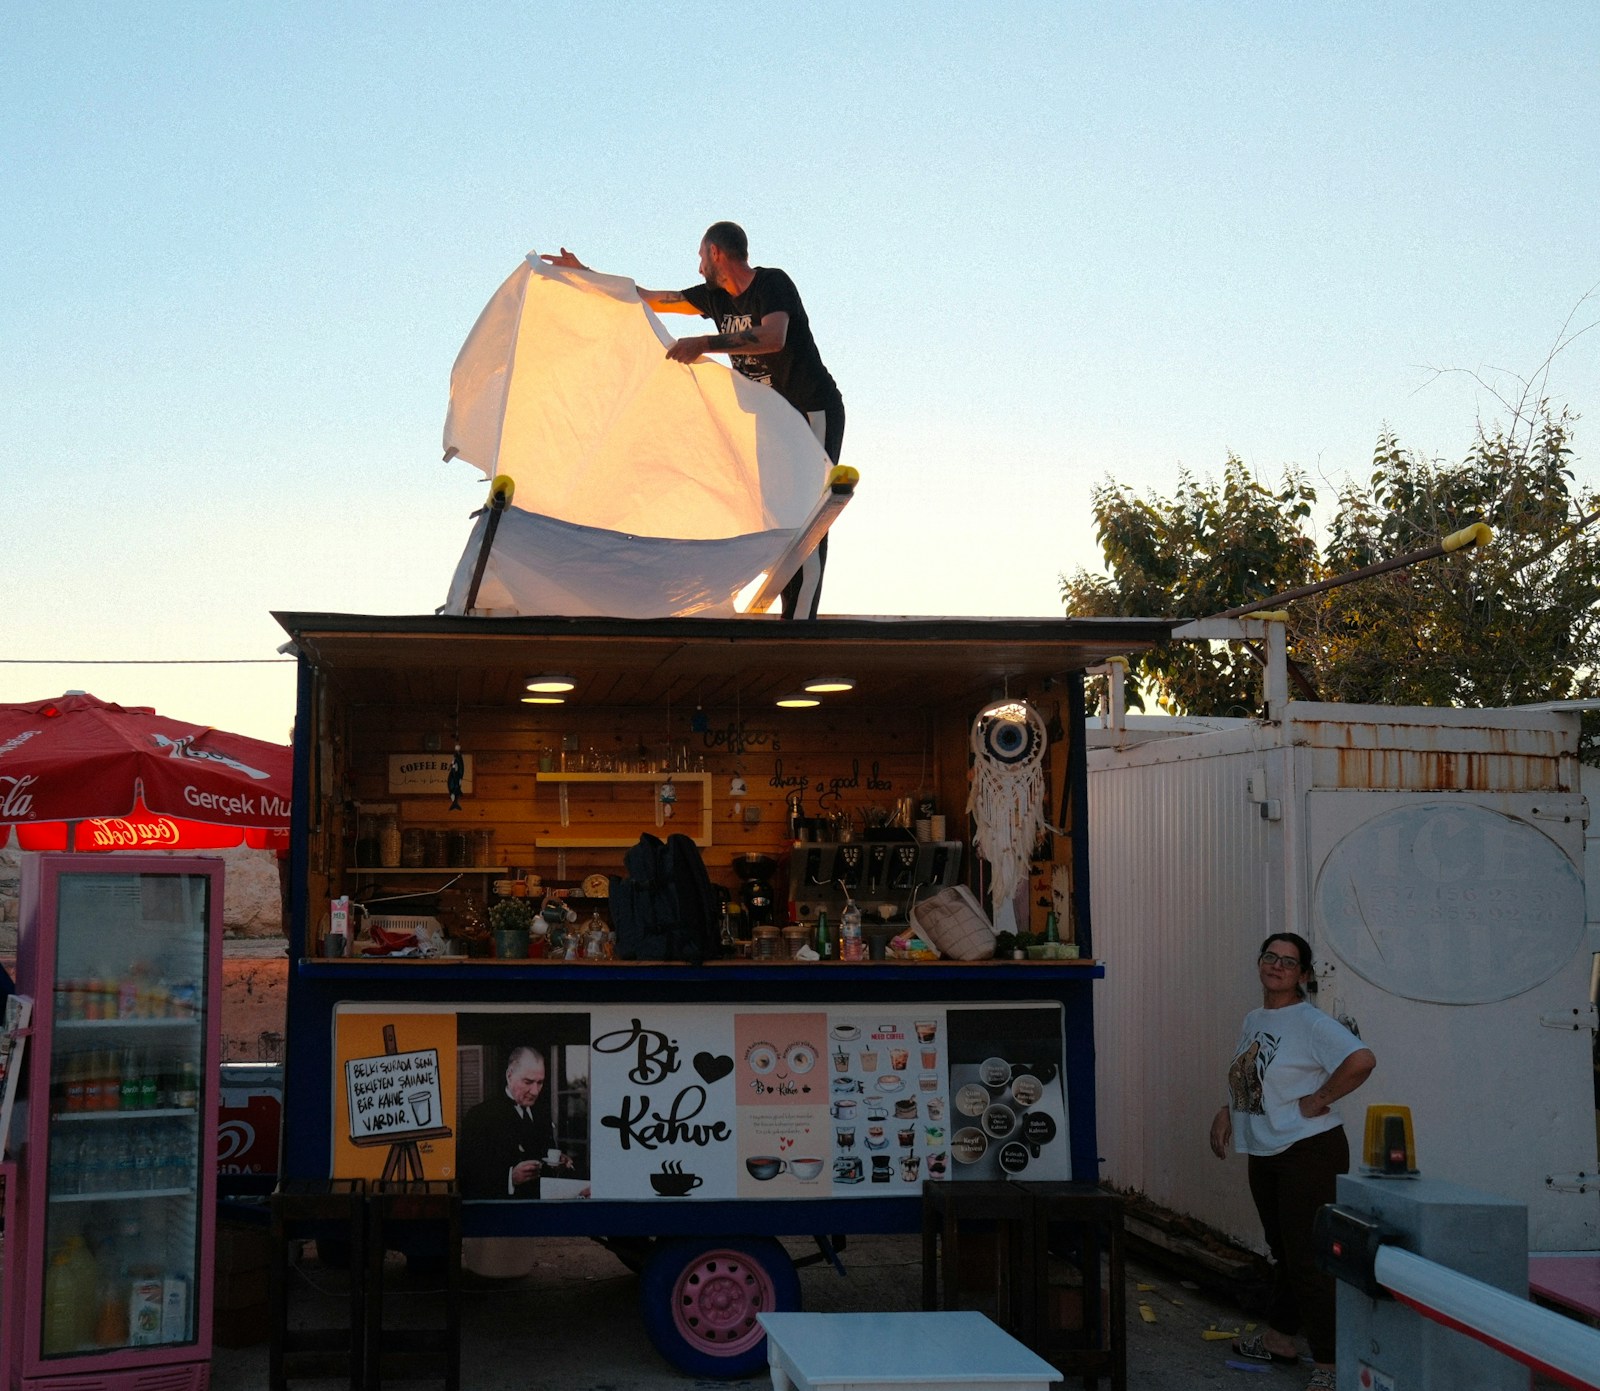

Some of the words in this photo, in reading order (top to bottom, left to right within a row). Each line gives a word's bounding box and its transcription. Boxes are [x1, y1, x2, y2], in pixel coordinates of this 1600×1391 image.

[400, 761, 437, 774] COFFEE
[816, 782, 826, 794] a
[819, 758, 860, 810] good
[184, 785, 255, 816] Gerçek
[593, 1018, 683, 1086] Bi
[353, 1076, 394, 1097] BEKLEYEN
[378, 1090, 404, 1109] KAHVE
[602, 1085, 734, 1151] Kahve
